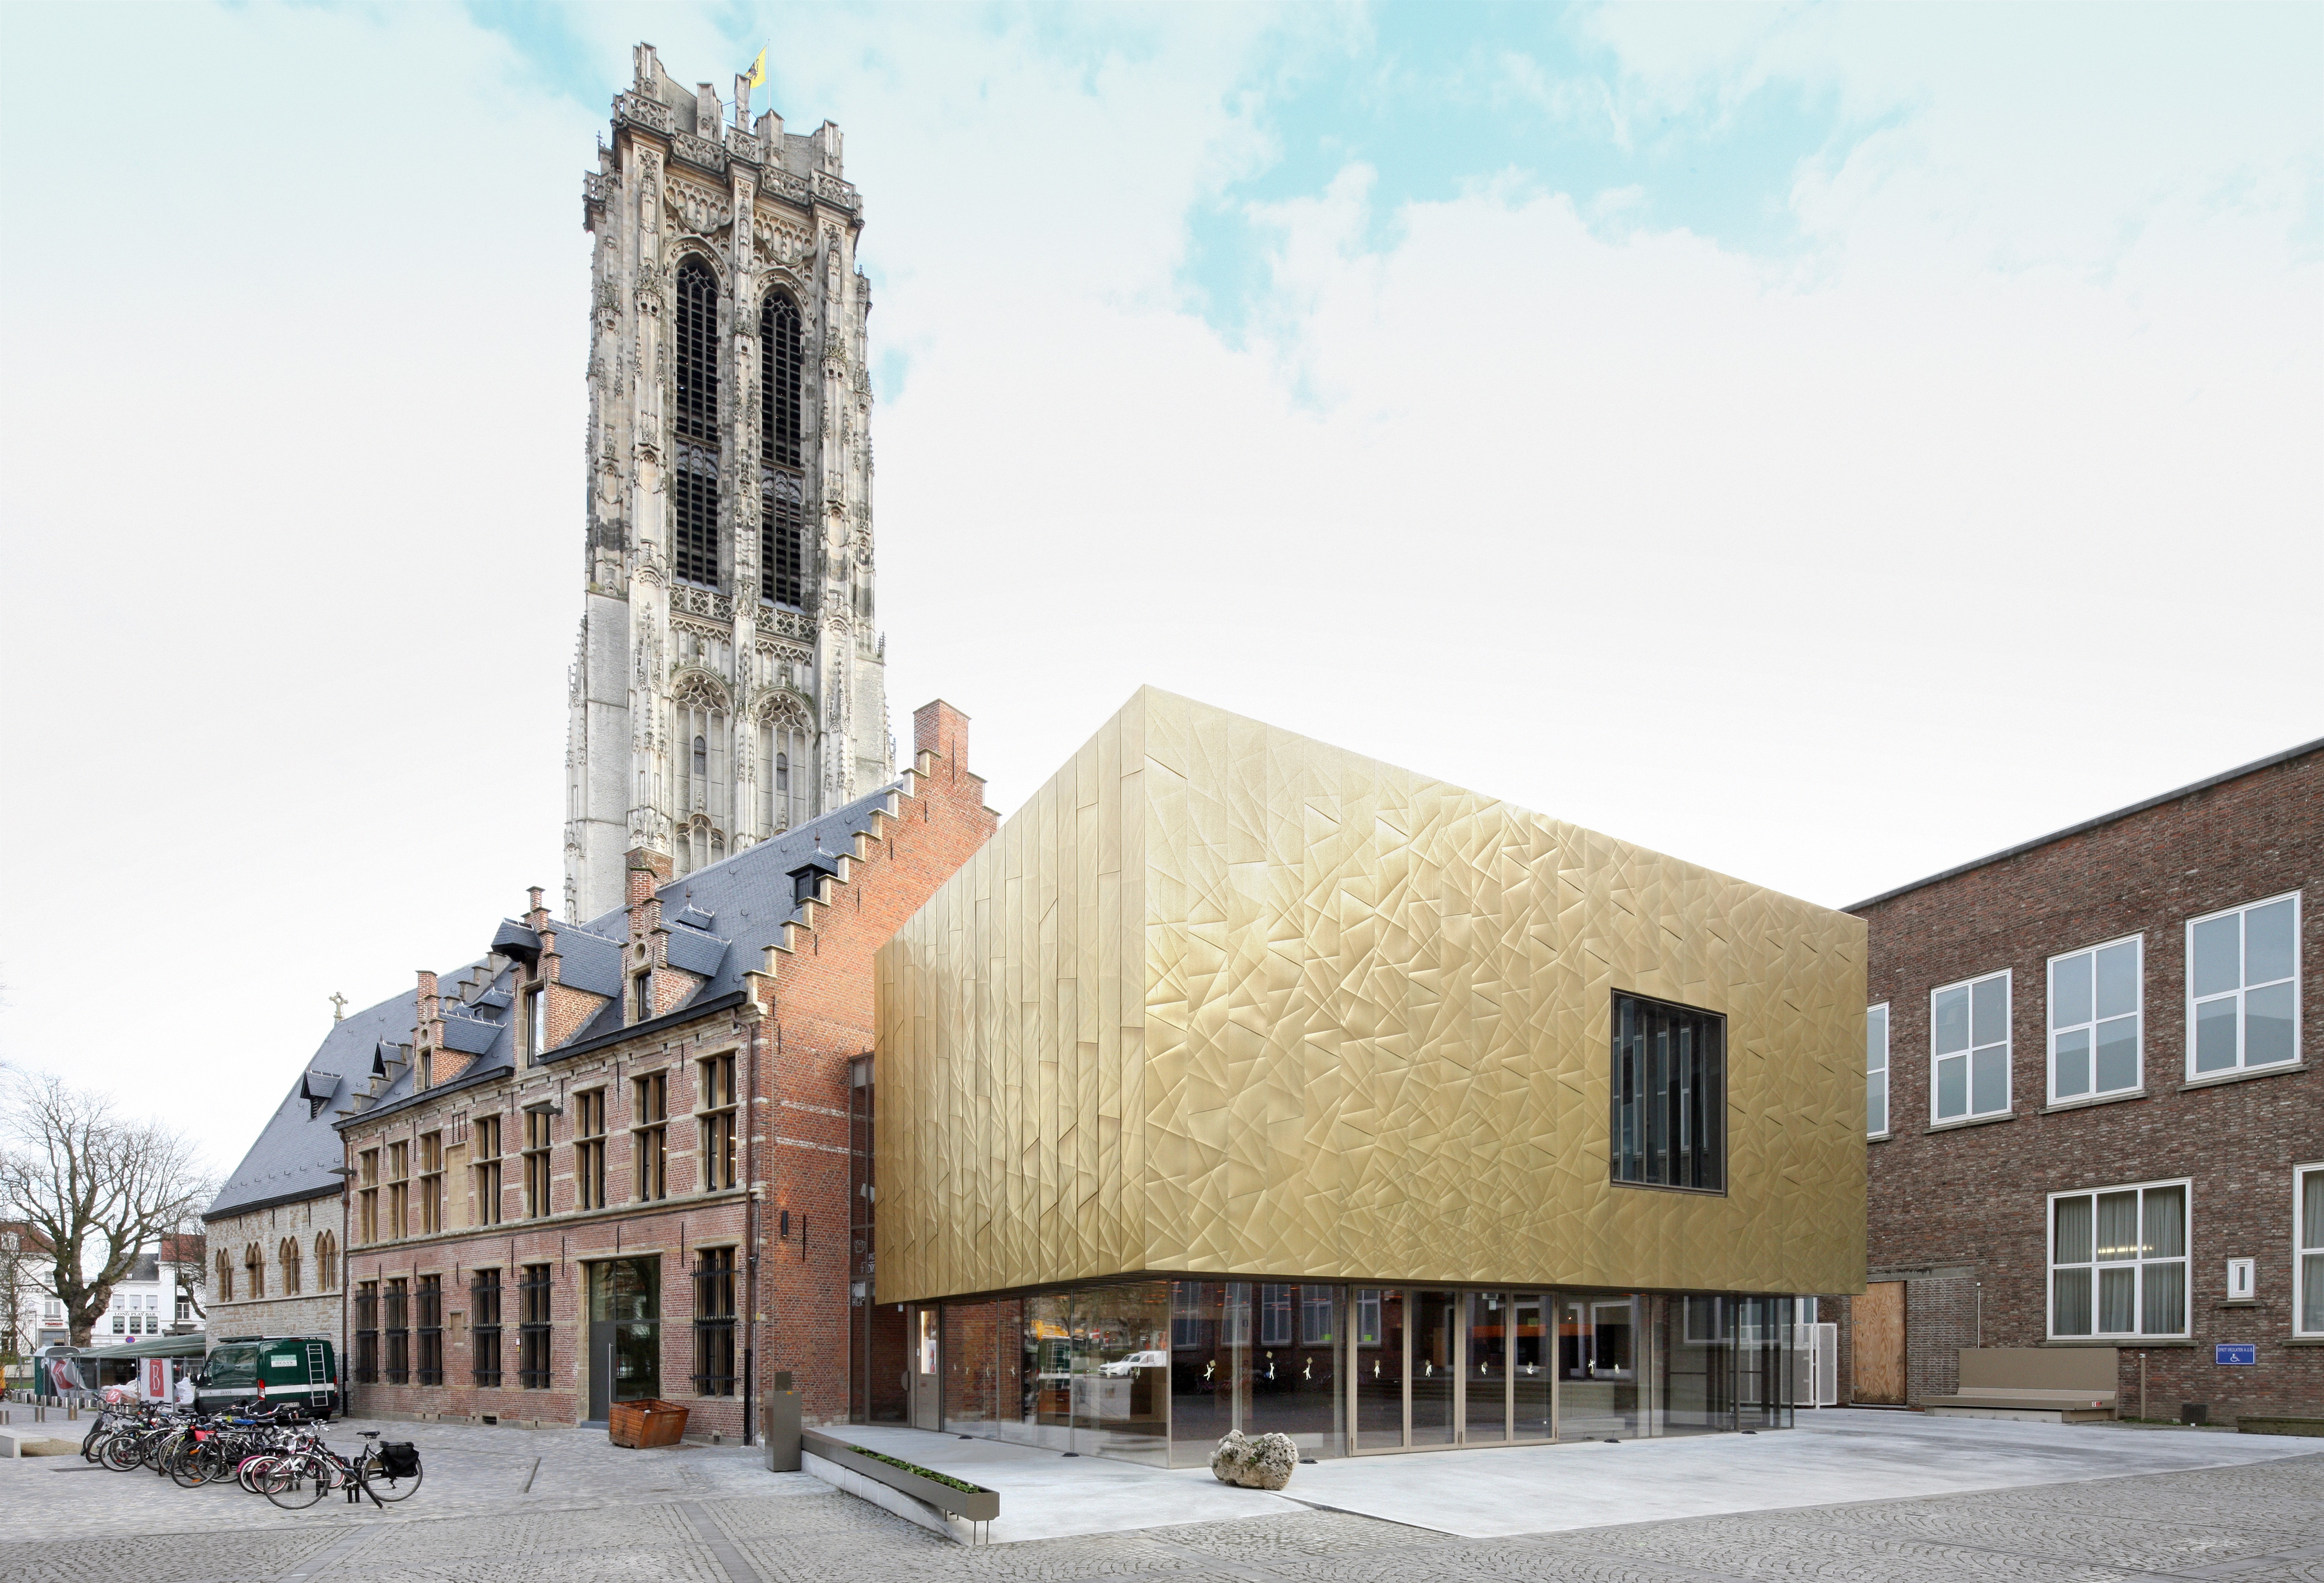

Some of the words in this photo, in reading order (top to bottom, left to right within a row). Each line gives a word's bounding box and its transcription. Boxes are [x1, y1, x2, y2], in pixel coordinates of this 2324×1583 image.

[152, 1365, 160, 1391] B
[111, 1391, 119, 1400] B
[324, 1454, 343, 1470] OXFORD
